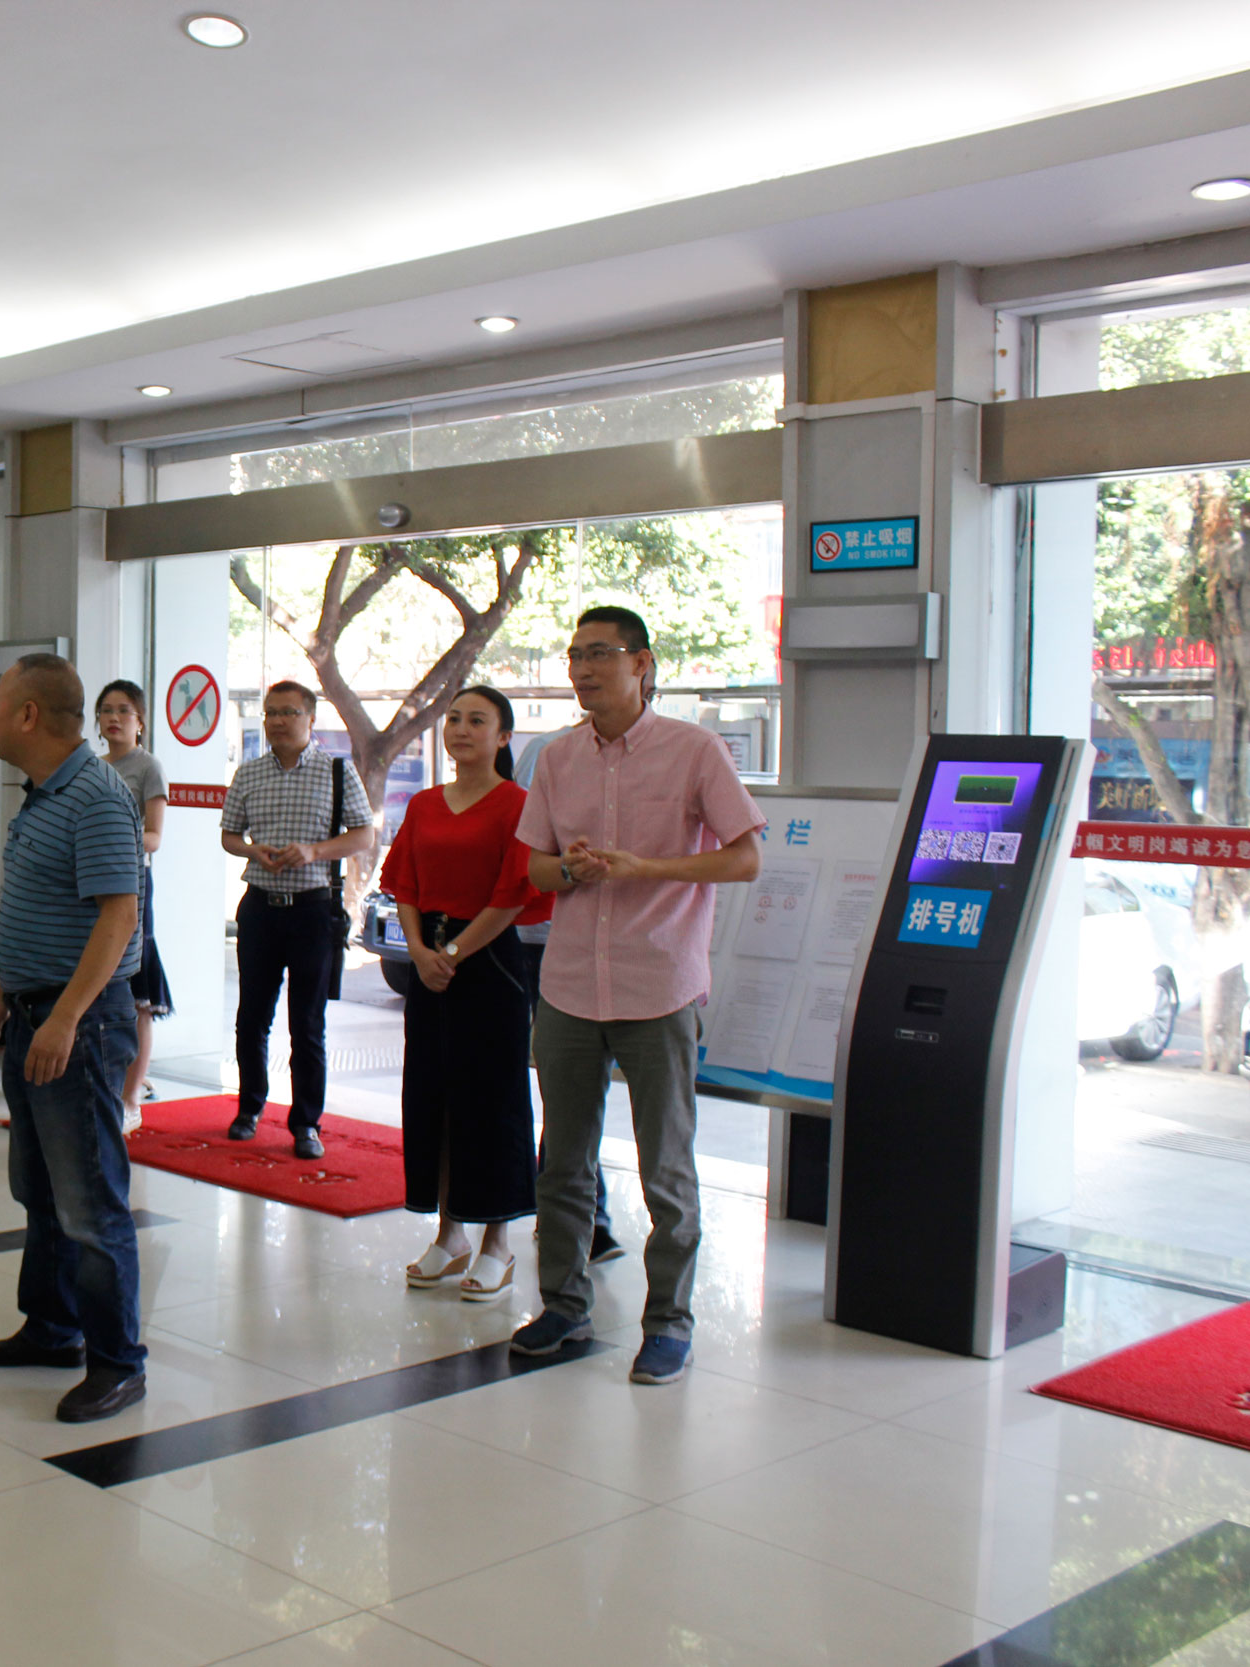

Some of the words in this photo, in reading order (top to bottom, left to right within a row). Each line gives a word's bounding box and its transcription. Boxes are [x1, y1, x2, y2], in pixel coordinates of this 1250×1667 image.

[845, 527, 912, 548] 禁止吸烟
[848, 550, 861, 560] NO
[864, 548, 908, 559] SMOKING
[907, 898, 982, 936] 排号机
